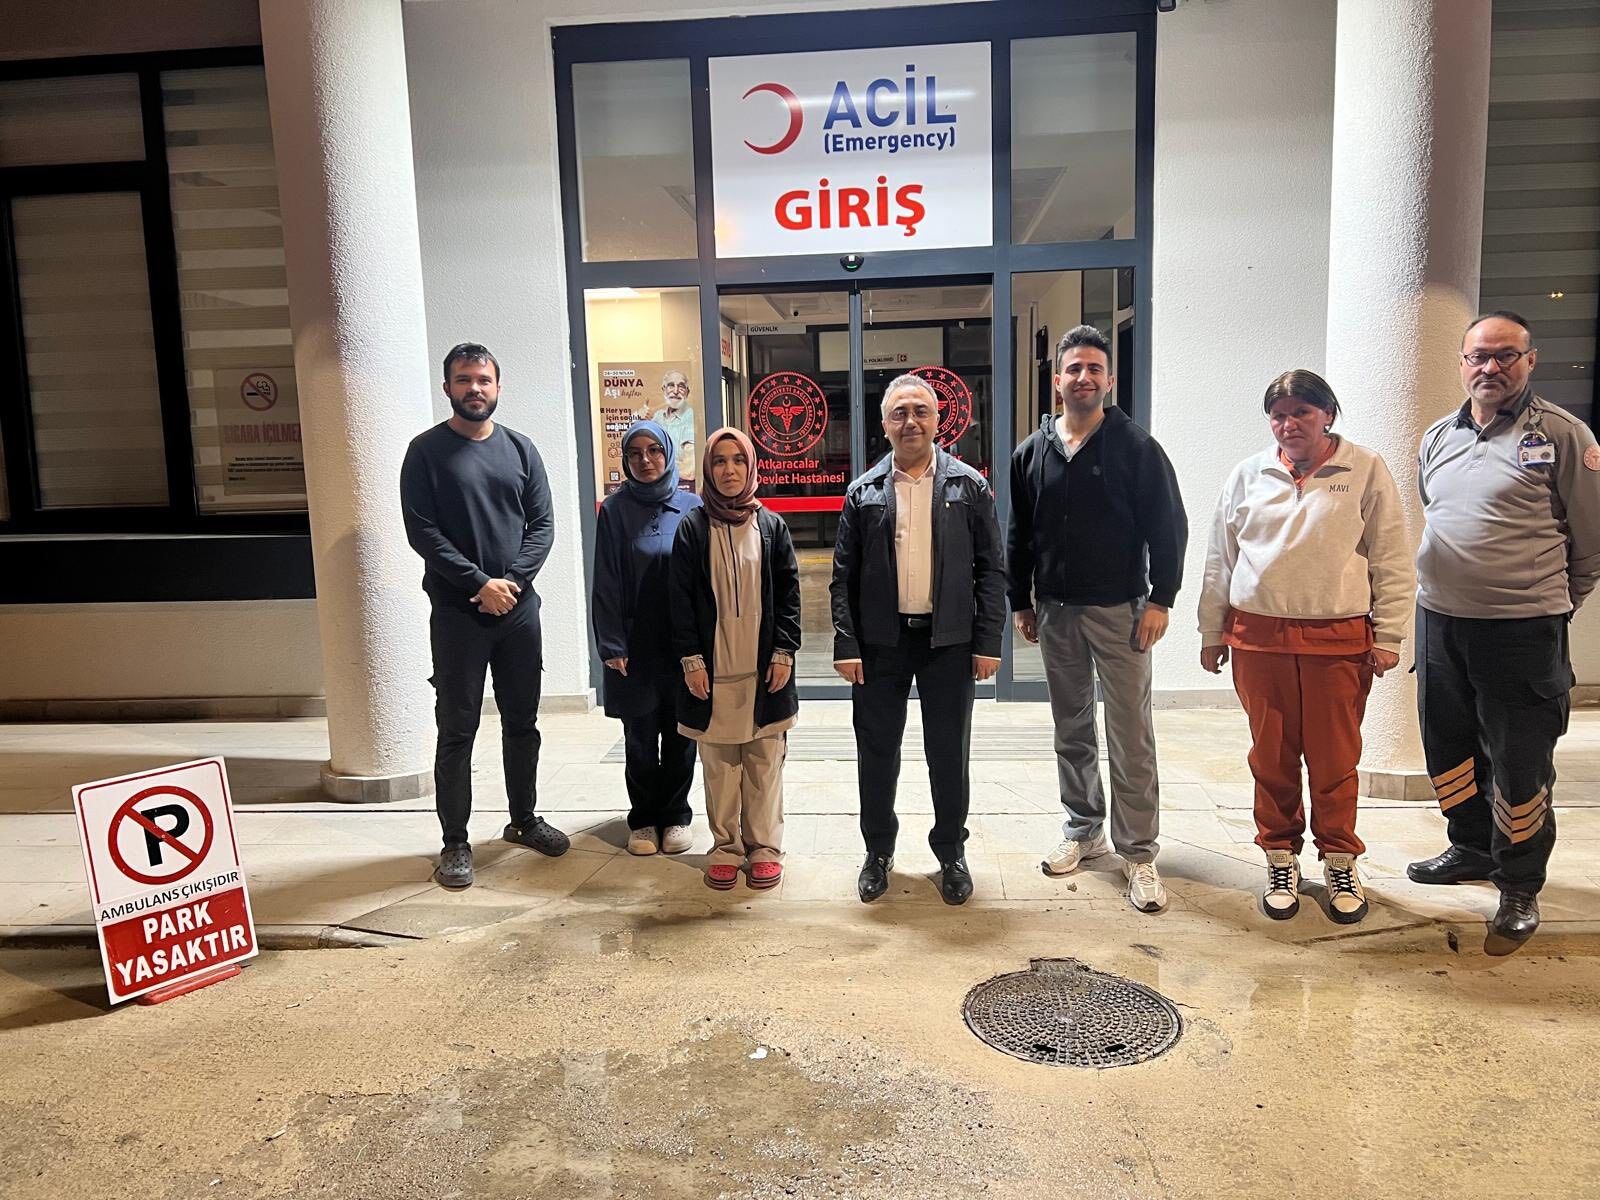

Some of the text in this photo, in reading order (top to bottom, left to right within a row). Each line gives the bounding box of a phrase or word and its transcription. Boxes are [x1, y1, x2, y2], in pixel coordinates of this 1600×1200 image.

[823, 64, 957, 130] ACİL
[824, 126, 955, 154] (Emergency)
[774, 175, 926, 237] GİRİŞ
[604, 376, 644, 388] DÜNYA
[604, 388, 620, 399] AŞI
[757, 457, 820, 469] Atkaracalar
[757, 472, 845, 484] Devlet Hastanesi
[100, 871, 240, 922] AMBULANS ÇIKIŞIDIR
[142, 900, 214, 944] PARK
[115, 924, 248, 987] YASAKTIR
